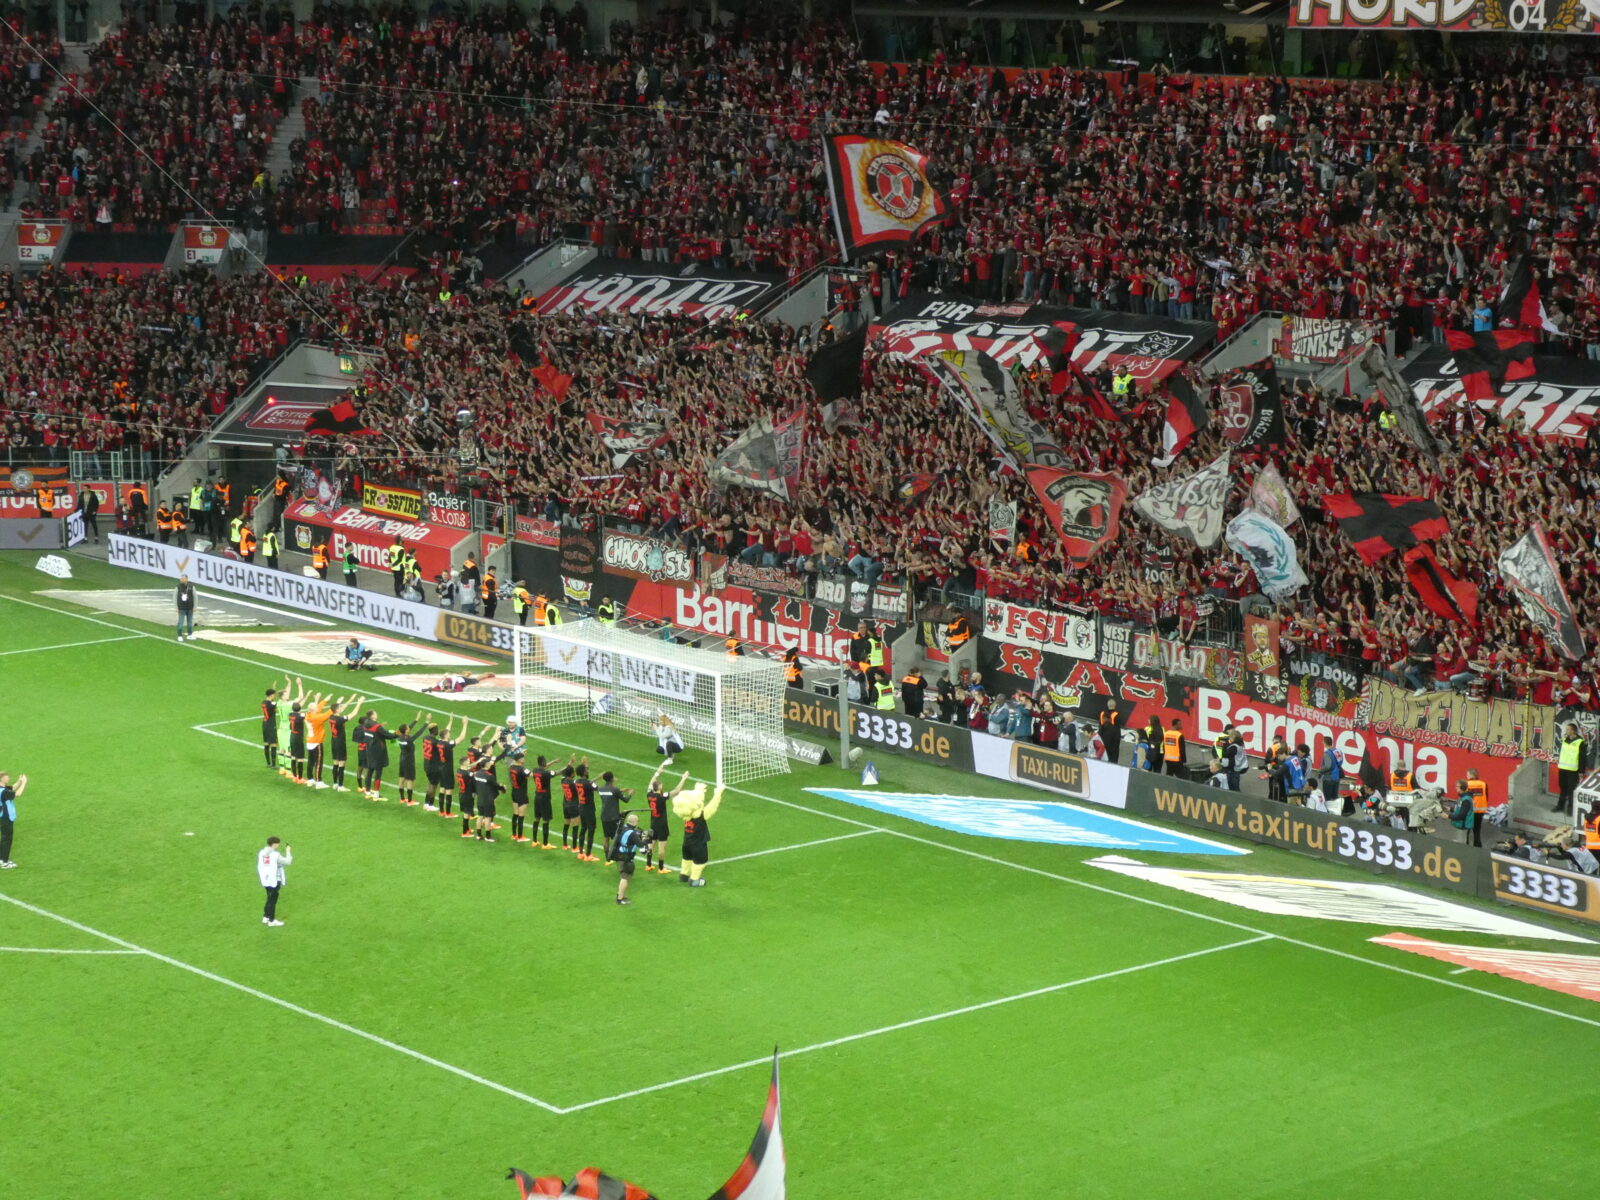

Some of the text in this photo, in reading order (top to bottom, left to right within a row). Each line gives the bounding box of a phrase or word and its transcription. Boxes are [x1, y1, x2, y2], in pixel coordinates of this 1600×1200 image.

[21, 248, 33, 257] E2
[187, 250, 196, 259] E1
[917, 300, 975, 321] FÜR
[428, 492, 467, 511] Bayer
[333, 508, 430, 541] Barenia
[108, 539, 166, 570] AHRTEN
[334, 533, 391, 568] Barme
[605, 531, 649, 567] CHAOS
[197, 558, 420, 631] FLUGHAFENTRANSFER u.v.m.
[1006, 605, 1069, 647] FSI
[1102, 623, 1131, 642] WEST
[1101, 638, 1129, 657] SIDE
[1100, 652, 1129, 670] BOYZ
[1290, 660, 1320, 676] MAD
[1287, 702, 1354, 730] LEVERKUSEN
[800, 747, 821, 760] trive
[1021, 754, 1079, 785] TAXI-RUF
[1153, 787, 1462, 883] www.taxiruf3333.de
